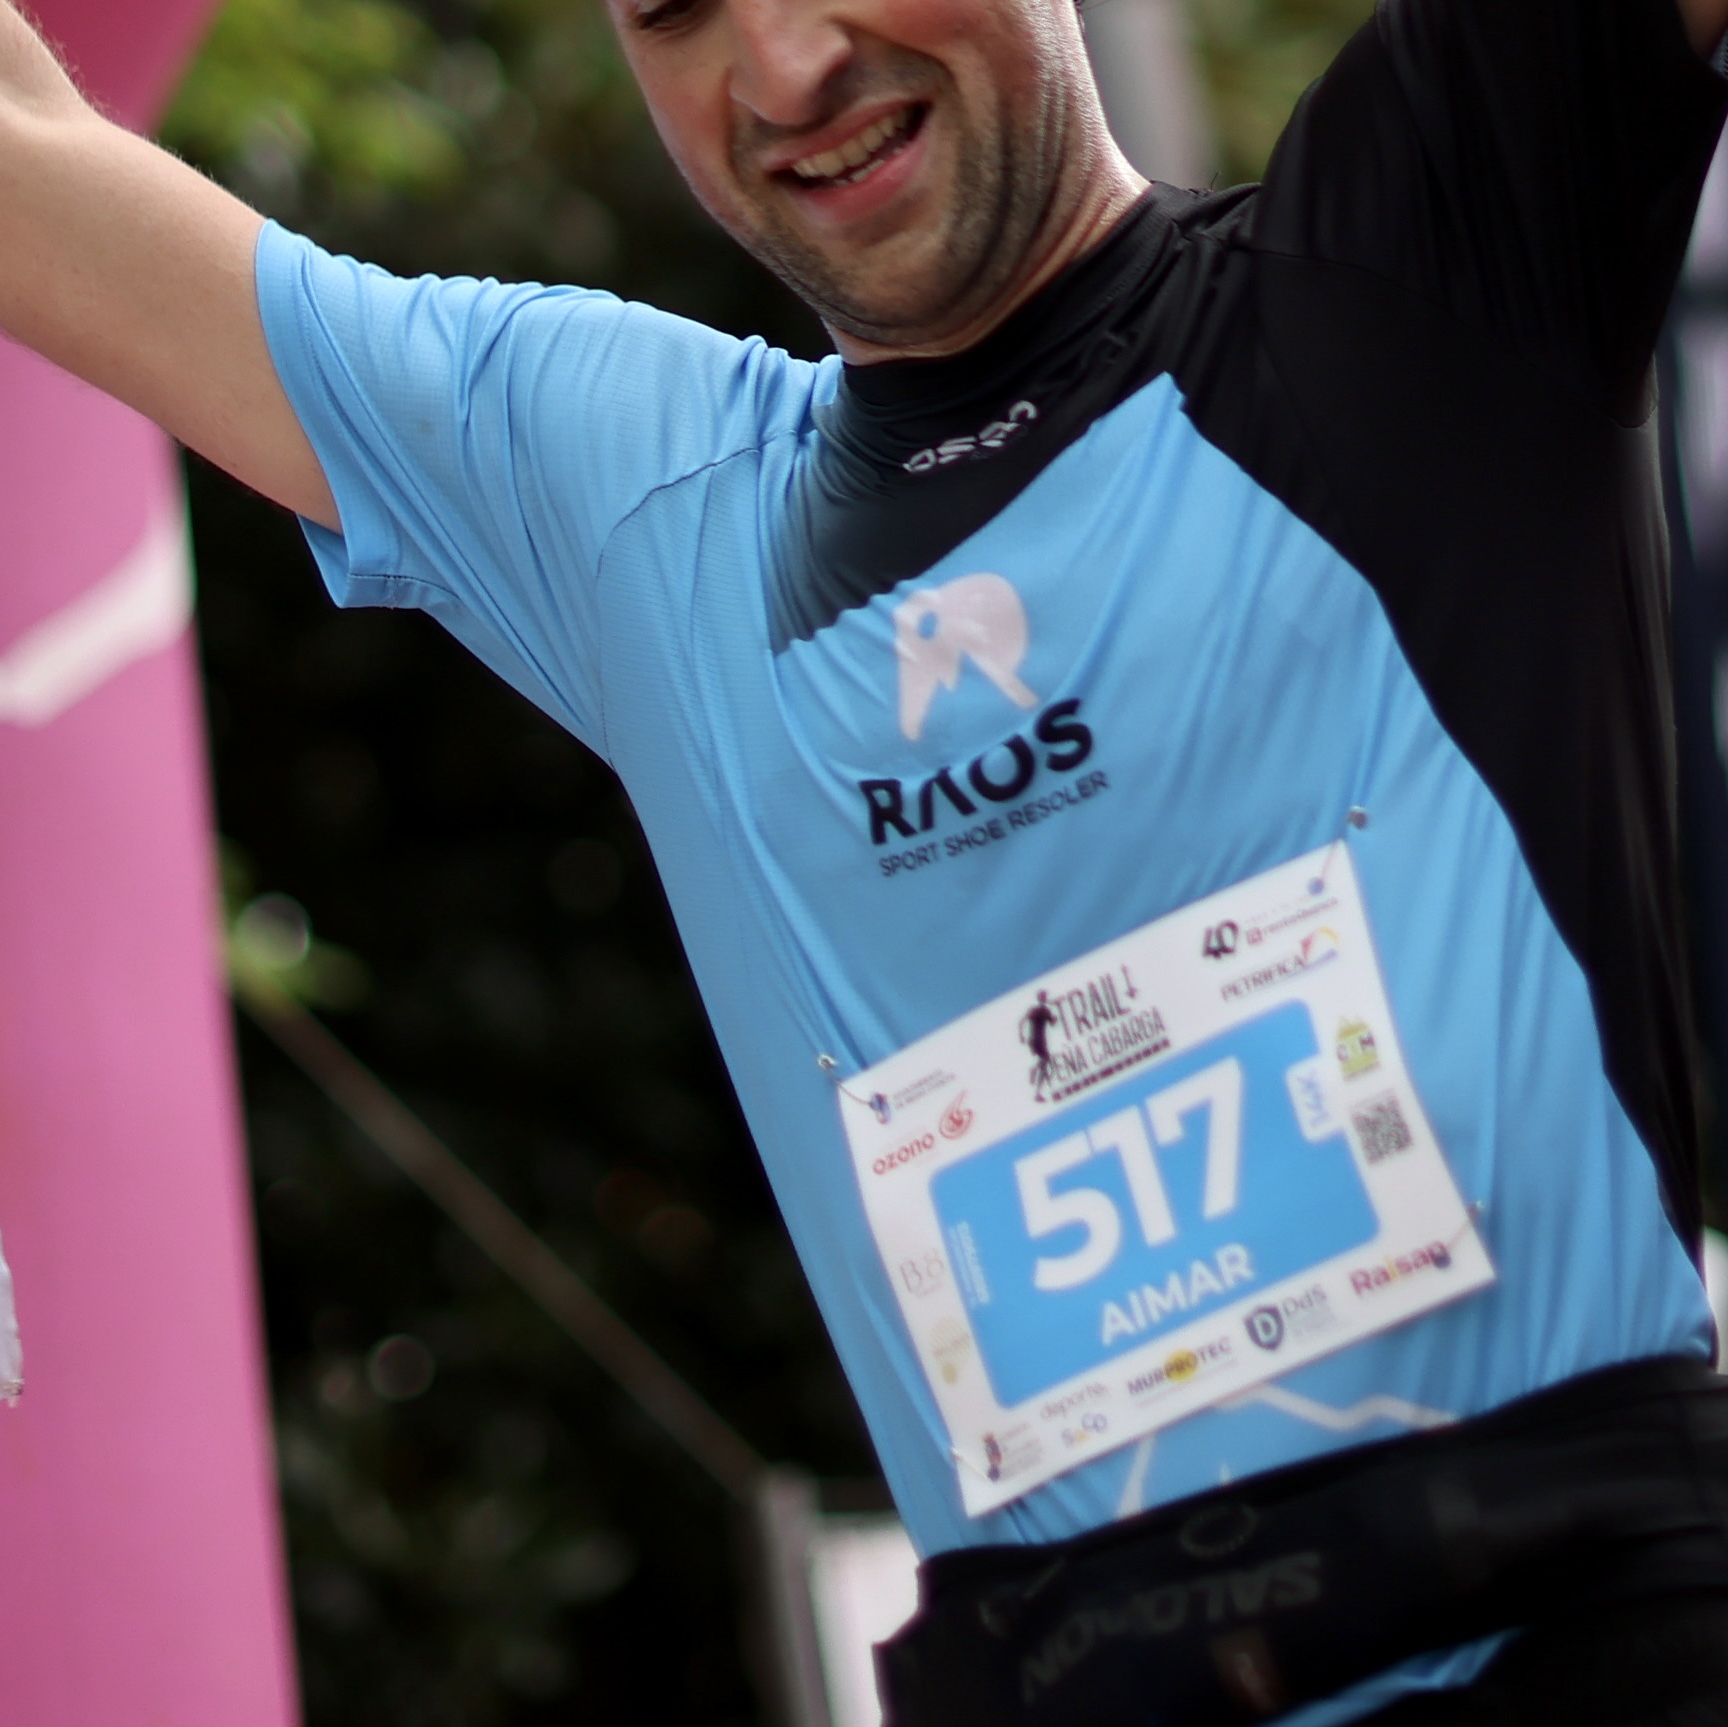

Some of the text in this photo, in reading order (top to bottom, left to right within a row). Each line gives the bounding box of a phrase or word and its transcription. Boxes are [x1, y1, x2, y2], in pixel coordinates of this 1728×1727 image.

[879, 769, 1111, 877] SPORT SHOE RESOLER
[1202, 919, 1239, 960] 40
[1048, 973, 1131, 1041] TRAIL
[1088, 1006, 1166, 1066] CABARGA
[1014, 1054, 1243, 1291] 517
[1101, 1241, 1256, 1348] AIMAR
[1127, 1335, 1232, 1395] MURPROTEC
